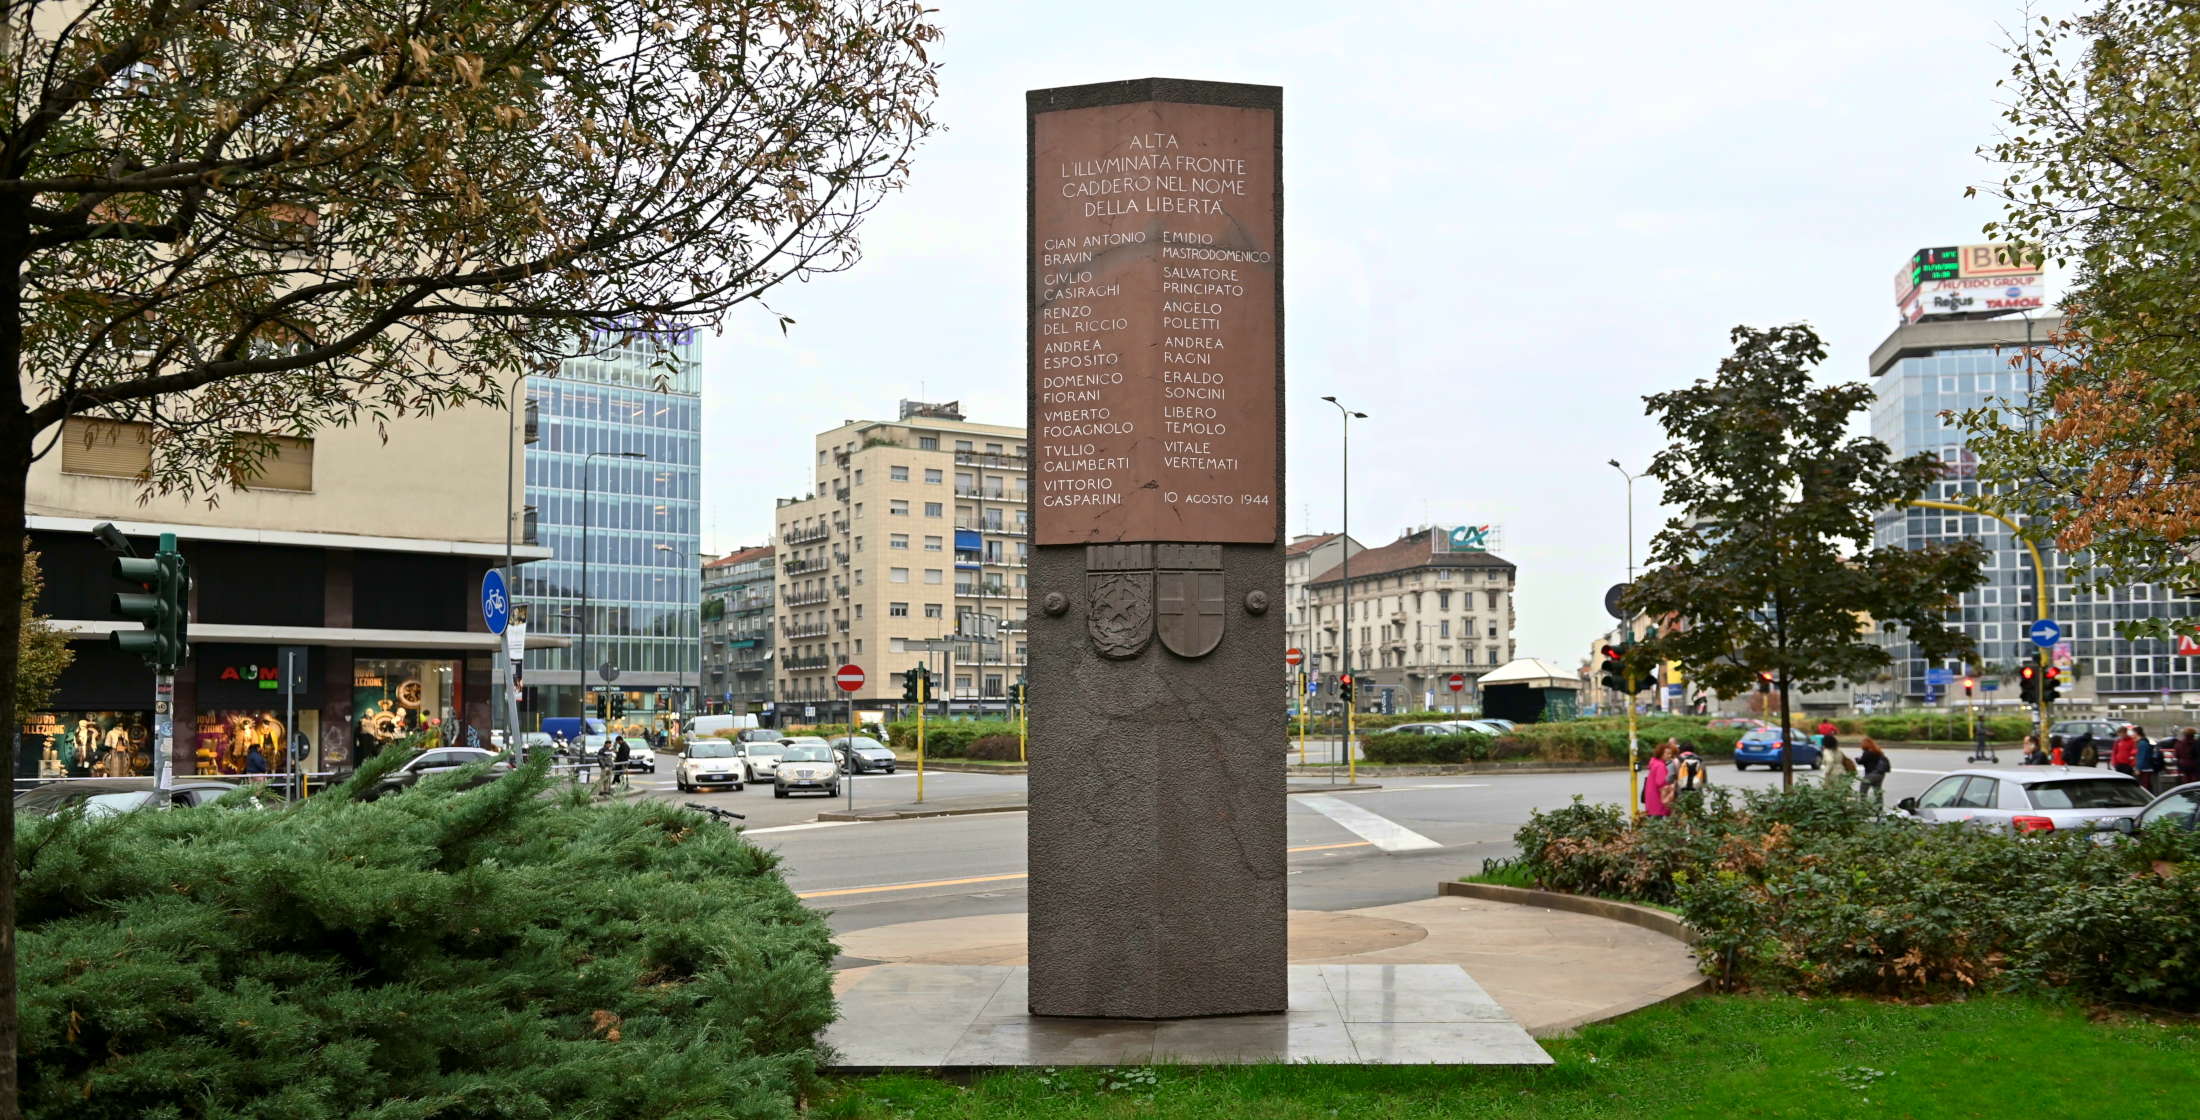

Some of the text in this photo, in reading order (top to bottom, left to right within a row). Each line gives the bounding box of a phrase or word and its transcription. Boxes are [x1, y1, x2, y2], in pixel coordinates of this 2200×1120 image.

[1129, 133, 1178, 150] ALTA
[1176, 155, 1247, 176] FRONTE
[1062, 175, 1246, 198] CADDERO NEL NOME
[1084, 199, 1138, 217] DELLA
[1044, 231, 1145, 250] GIAN ANTONIO
[1163, 231, 1212, 245] EMIDIO
[1043, 251, 1091, 267] BRAVIN
[1162, 247, 1270, 263] MASTRODOMENICO
[1043, 271, 1092, 286] GIVLIO
[1163, 267, 1238, 282] SALVATORE
[1163, 282, 1243, 297] PRINCIPATO
[1934, 277, 2035, 291] SHISEIDO GROUP
[1043, 283, 1120, 302] CASIRAGHI
[1163, 301, 1221, 315] ANGELO
[1934, 296, 1973, 310] Regus
[1986, 297, 2044, 309] TAMOIL
[1043, 305, 1091, 320] RENZO
[1043, 318, 1127, 336] DEL RICCIO
[1163, 317, 1219, 331] POLETTI
[1044, 339, 1102, 355] ANDREA
[1164, 336, 1224, 350] ANDREA
[1043, 353, 1117, 370] ESPOSITO
[1164, 351, 1210, 366] RAGNI
[1043, 372, 1122, 389] DOMENICO
[1163, 371, 1223, 385] ERALDO
[1043, 390, 1100, 405] FIORANI
[1164, 387, 1224, 401] SONCINI
[1043, 408, 1109, 422] VMBERTO
[1164, 406, 1216, 420] LIBERO
[1043, 421, 1133, 439] FOGAGNOLO
[1164, 421, 1225, 435] TEMOLO
[1044, 443, 1095, 457] TVLLIO
[1164, 441, 1210, 454] VITALE
[1043, 457, 1129, 473] GALIMBERTI
[1164, 457, 1237, 471] VERTEMATI
[1043, 478, 1111, 491] VITTORIO
[1043, 492, 1121, 507] GASPARINI
[1185, 494, 1233, 506] AGOSTO
[1240, 494, 1268, 506] 1944
